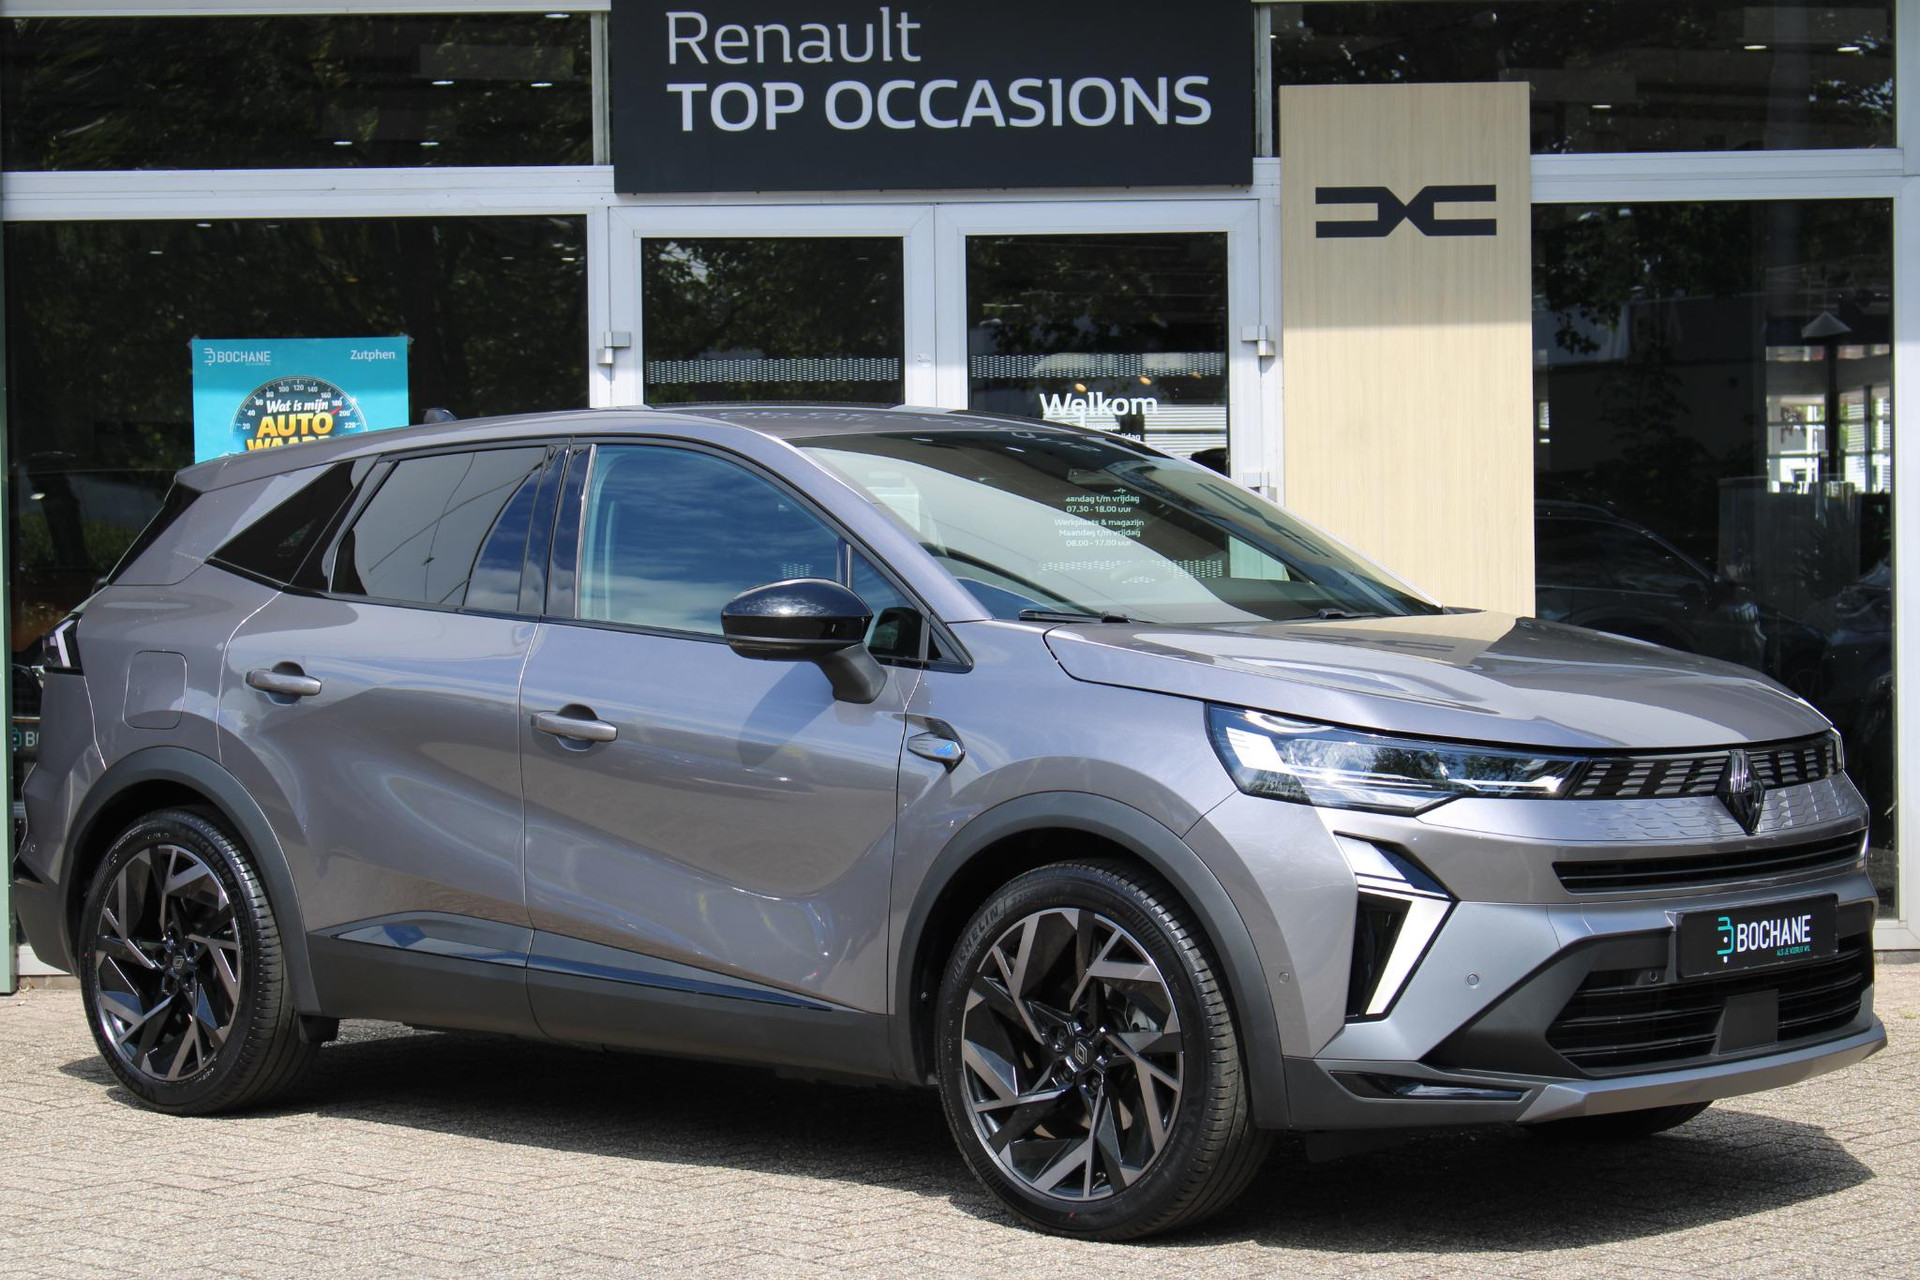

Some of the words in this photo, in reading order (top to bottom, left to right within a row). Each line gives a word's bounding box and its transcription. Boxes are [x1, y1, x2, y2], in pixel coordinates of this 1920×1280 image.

[666, 7, 922, 65] Renault
[666, 82, 805, 132] TOP
[825, 76, 1213, 131] OCCASIONS
[217, 350, 271, 363] BOCHANE
[350, 349, 396, 362] Zutphen
[266, 399, 292, 414] Wat
[293, 398, 303, 409] is
[303, 398, 329, 414] mijn
[1038, 391, 1159, 416] Welkom
[246, 409, 256, 417] 40
[242, 422, 251, 430] 20
[256, 411, 334, 438] AUTO
[344, 421, 357, 429] 220
[1065, 494, 1095, 504] aandag
[1095, 494, 1111, 503] t/m
[1112, 494, 1140, 504] vrijdag
[1108, 518, 1145, 528] magazijn
[1113, 527, 1141, 538] vrijdag
[1736, 914, 1812, 953] BOCHANE
